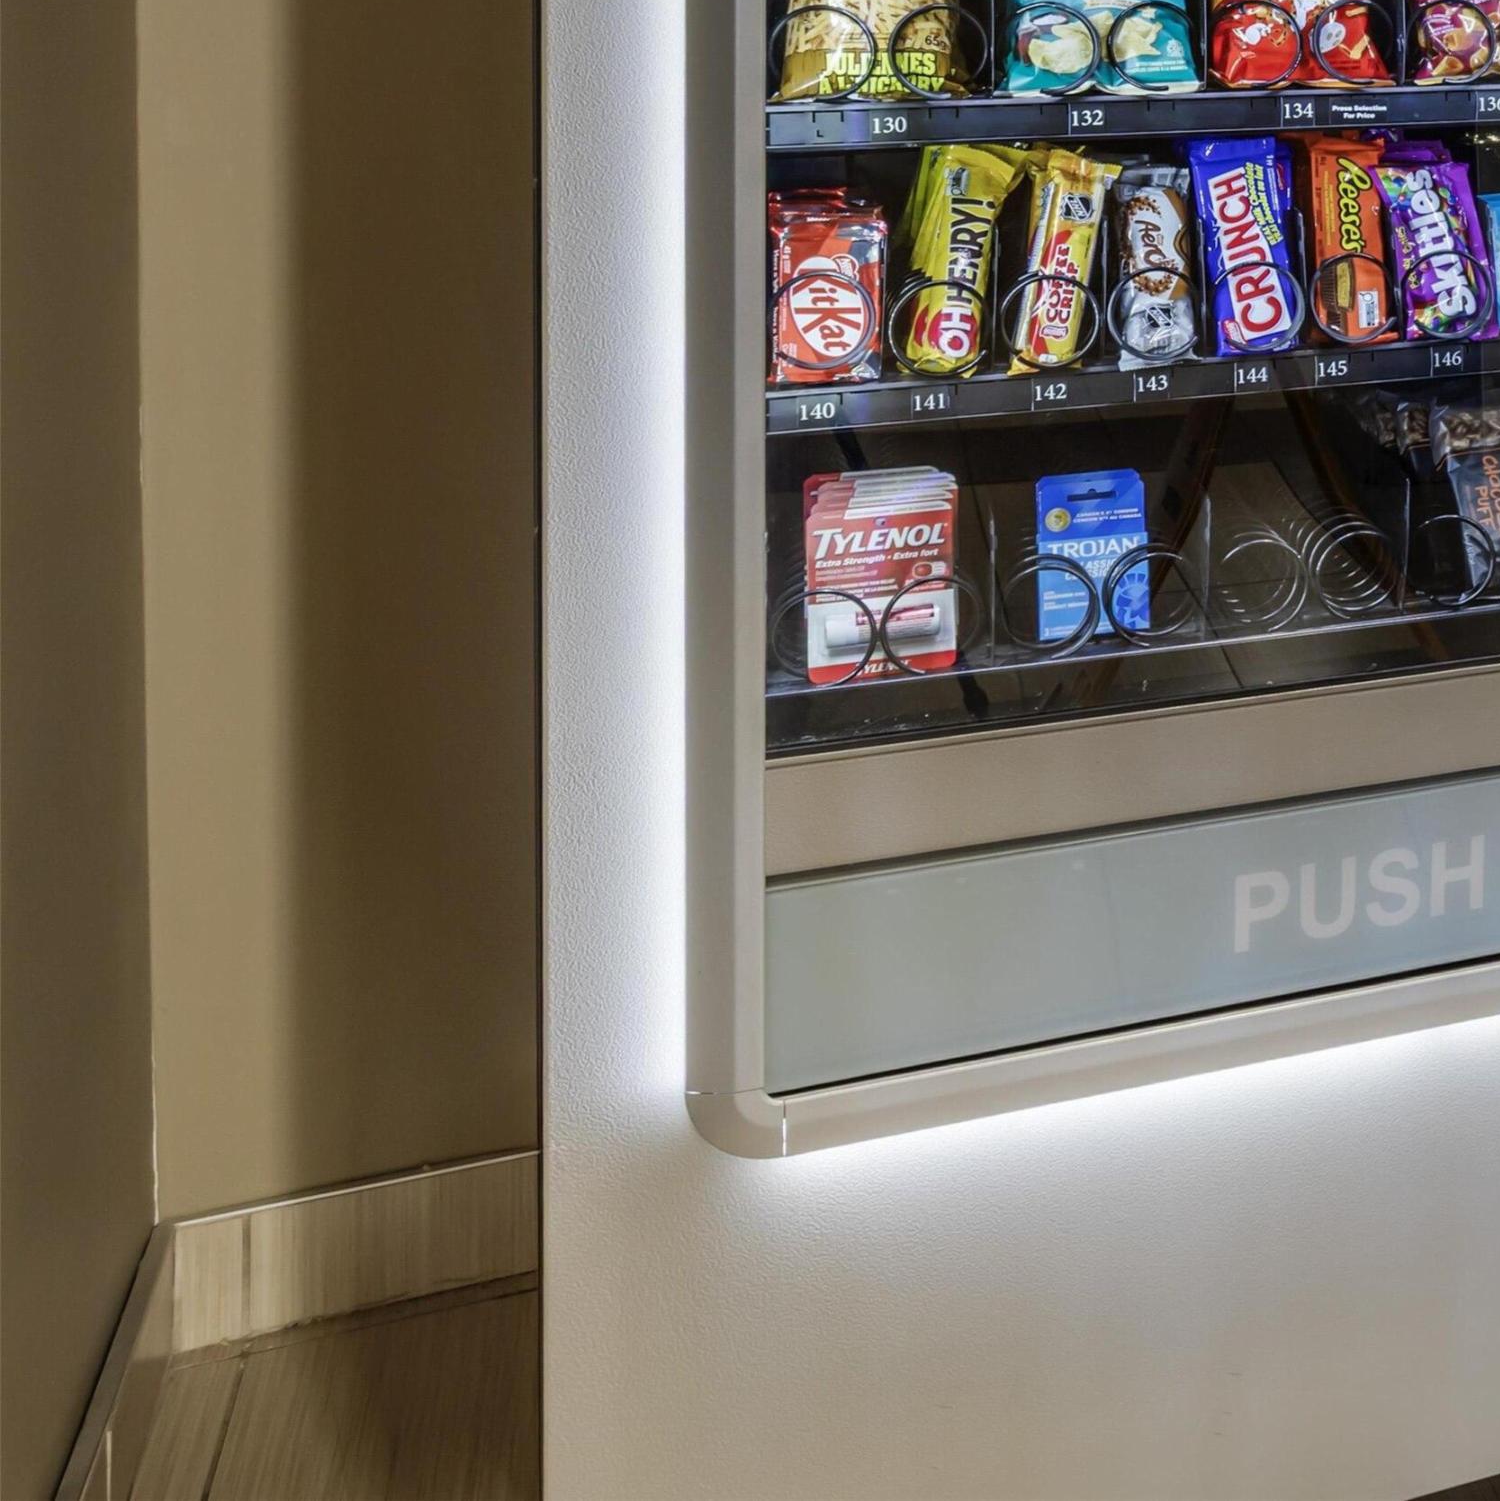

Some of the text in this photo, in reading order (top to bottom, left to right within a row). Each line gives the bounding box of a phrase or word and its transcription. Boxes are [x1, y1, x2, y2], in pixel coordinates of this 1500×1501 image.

[1071, 110, 1105, 128] 132
[1283, 103, 1314, 120] 134
[872, 116, 908, 135] 130
[1336, 156, 1372, 253] Reese's
[947, 197, 997, 306] HENRY!
[1134, 219, 1167, 270] Aero
[1213, 173, 1284, 333] CRUNCH
[791, 267, 862, 352] KitKat
[938, 306, 978, 358] OH
[1318, 360, 1348, 378] 145
[1433, 350, 1463, 368] 146
[1136, 375, 1169, 393] 143
[1236, 366, 1269, 385] 144
[912, 393, 947, 412] 141
[1034, 383, 1068, 402] 142
[800, 402, 836, 422] 140
[1475, 485, 1497, 530] PUFF
[812, 522, 945, 560] TYLENOL
[1047, 536, 1139, 558] TROJAN
[815, 547, 940, 569] Extra Strength Extra fort
[1233, 833, 1486, 954] PUSH
